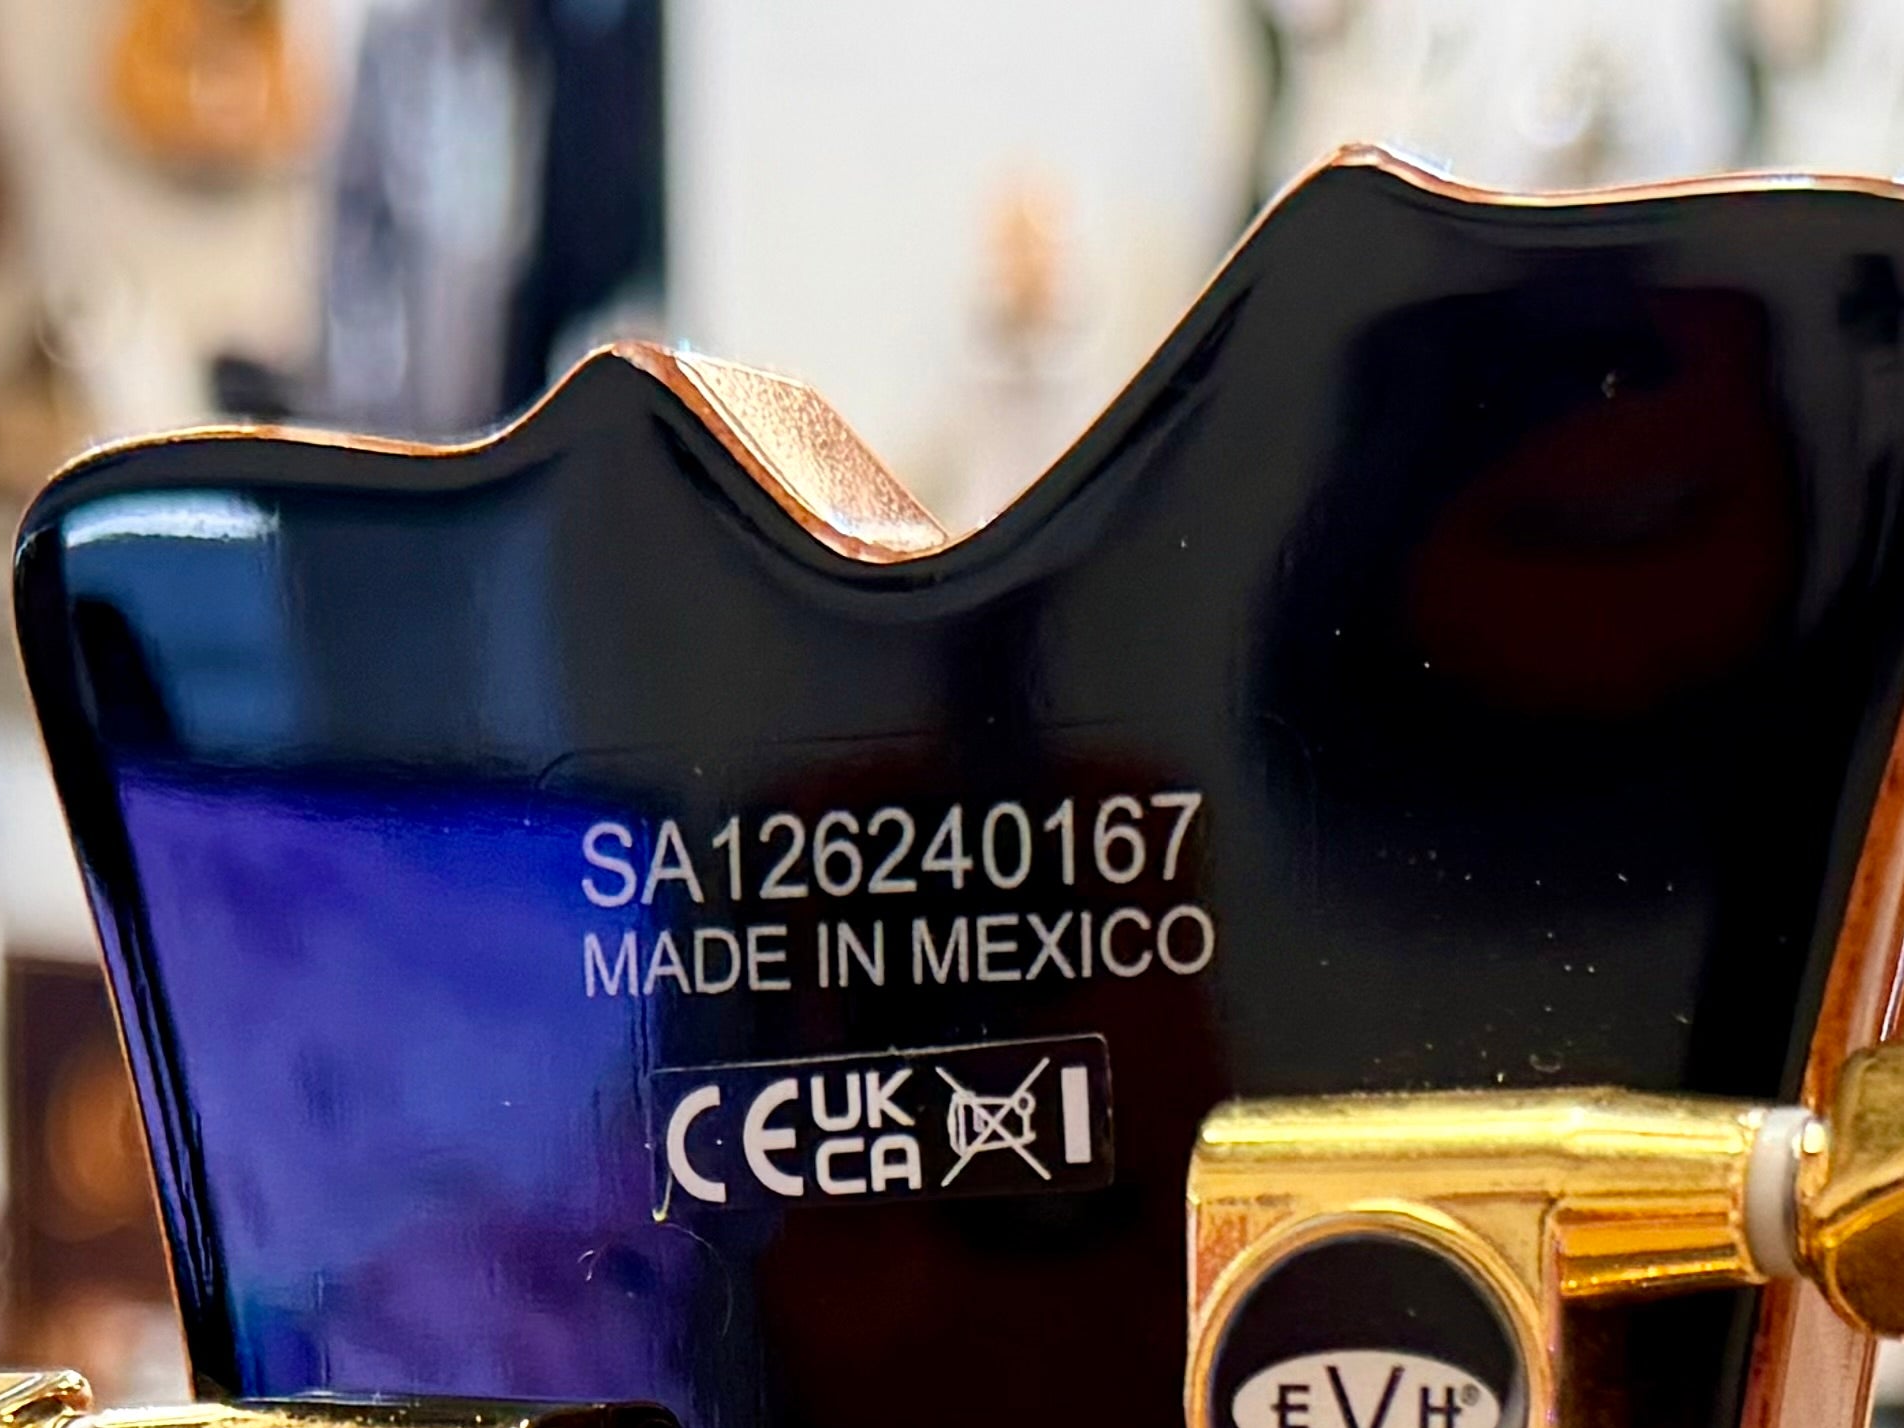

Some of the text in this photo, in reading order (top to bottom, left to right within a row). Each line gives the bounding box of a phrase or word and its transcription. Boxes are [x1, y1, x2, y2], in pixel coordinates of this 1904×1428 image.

[581, 791, 1203, 908] SA126240167
[584, 904, 1216, 998] MADE IN MEXICO
[666, 1077, 805, 1203] CE
[809, 1068, 915, 1132] UK
[815, 1133, 923, 1196] CA
